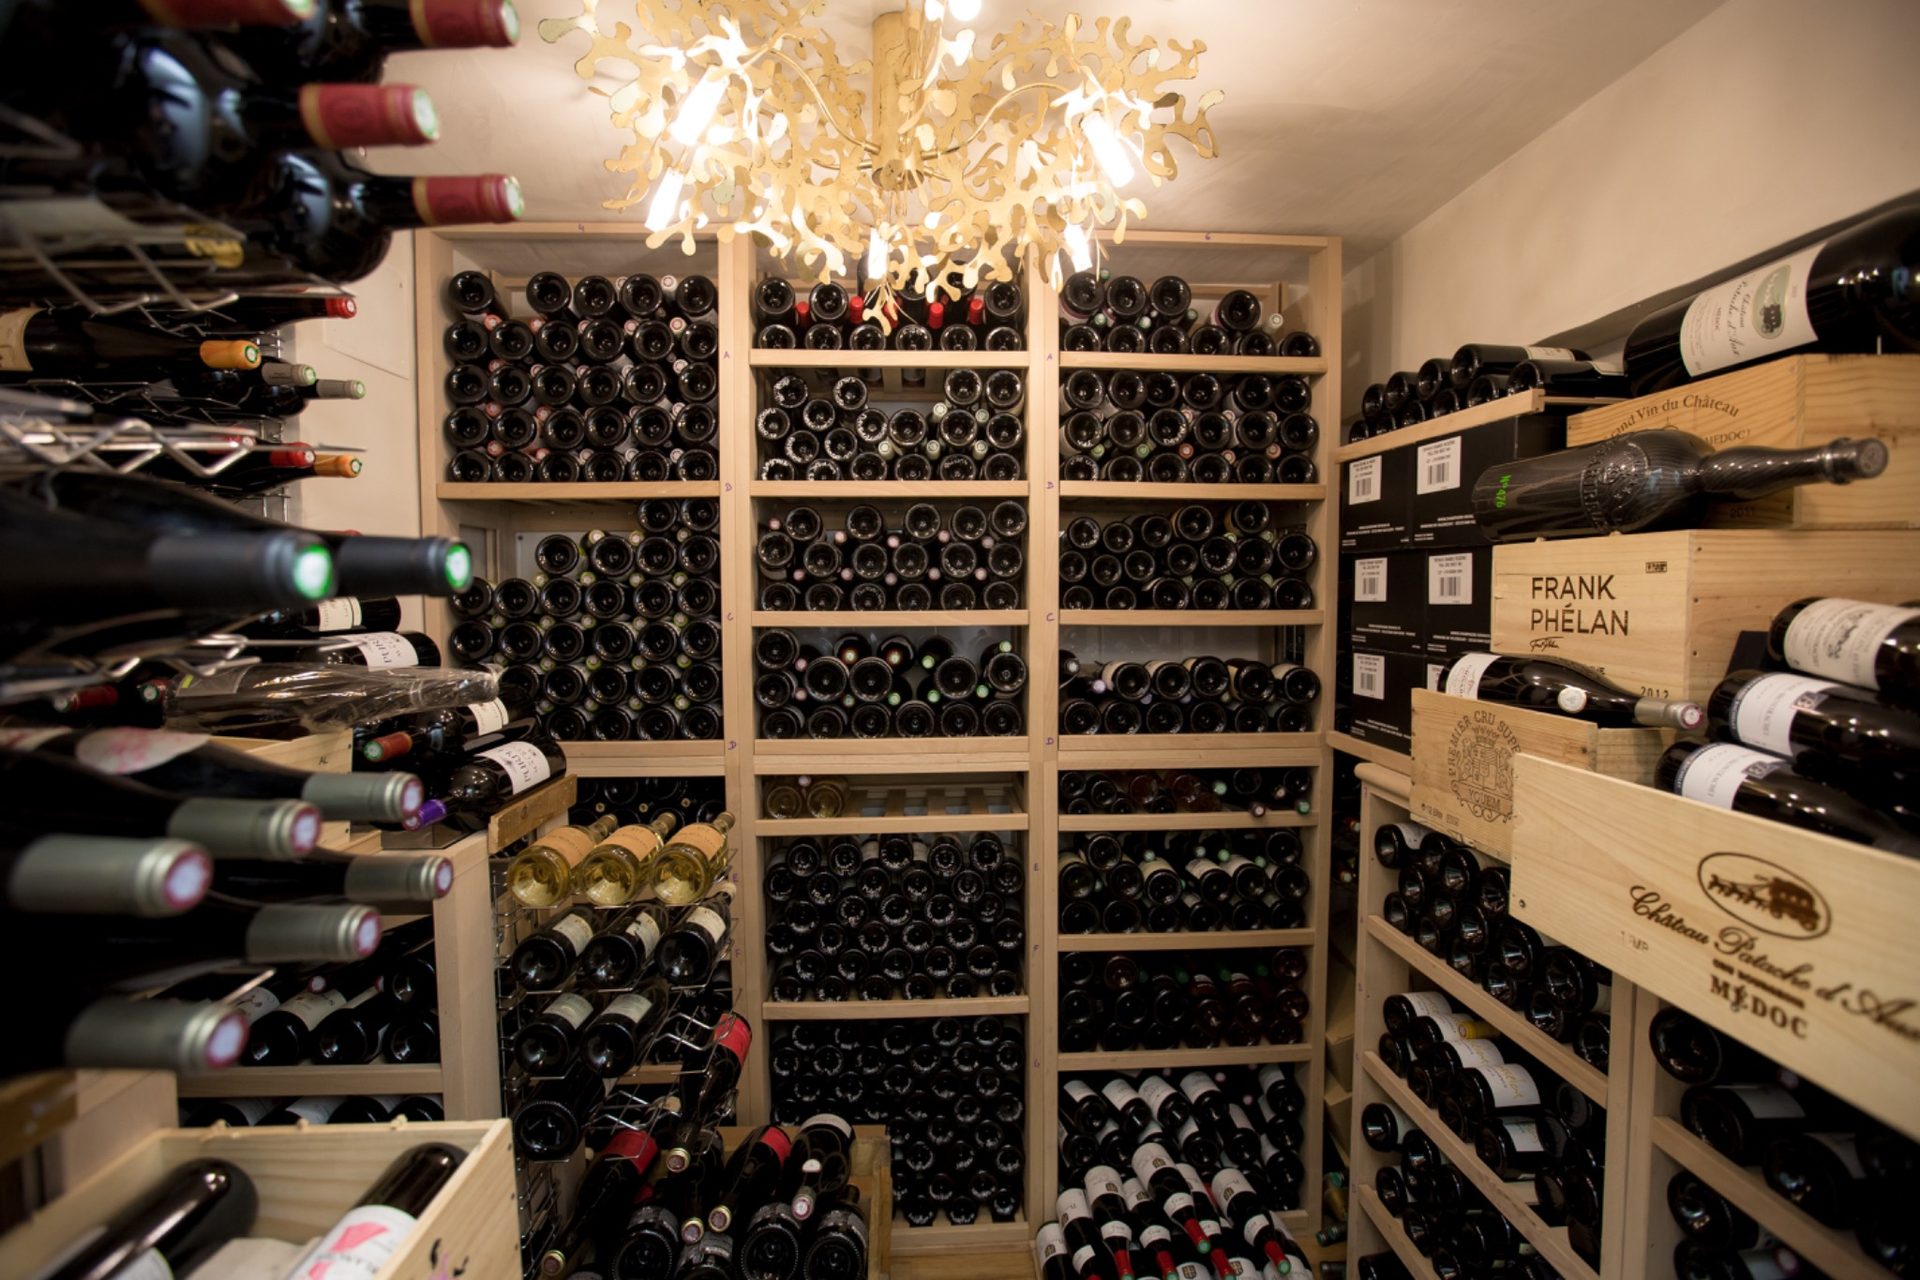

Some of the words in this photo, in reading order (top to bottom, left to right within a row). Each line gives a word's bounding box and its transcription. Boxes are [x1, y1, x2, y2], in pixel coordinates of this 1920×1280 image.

[1635, 405, 1659, 422] Vin
[1662, 398, 1680, 413] du
[1683, 393, 1740, 418] Château
[1531, 574, 1617, 601] FRANK
[1530, 602, 1630, 636] PHÉLAN
[1473, 709, 1497, 725] CRU
[1629, 884, 1710, 945] Château
[1713, 925, 1814, 991] Patache
